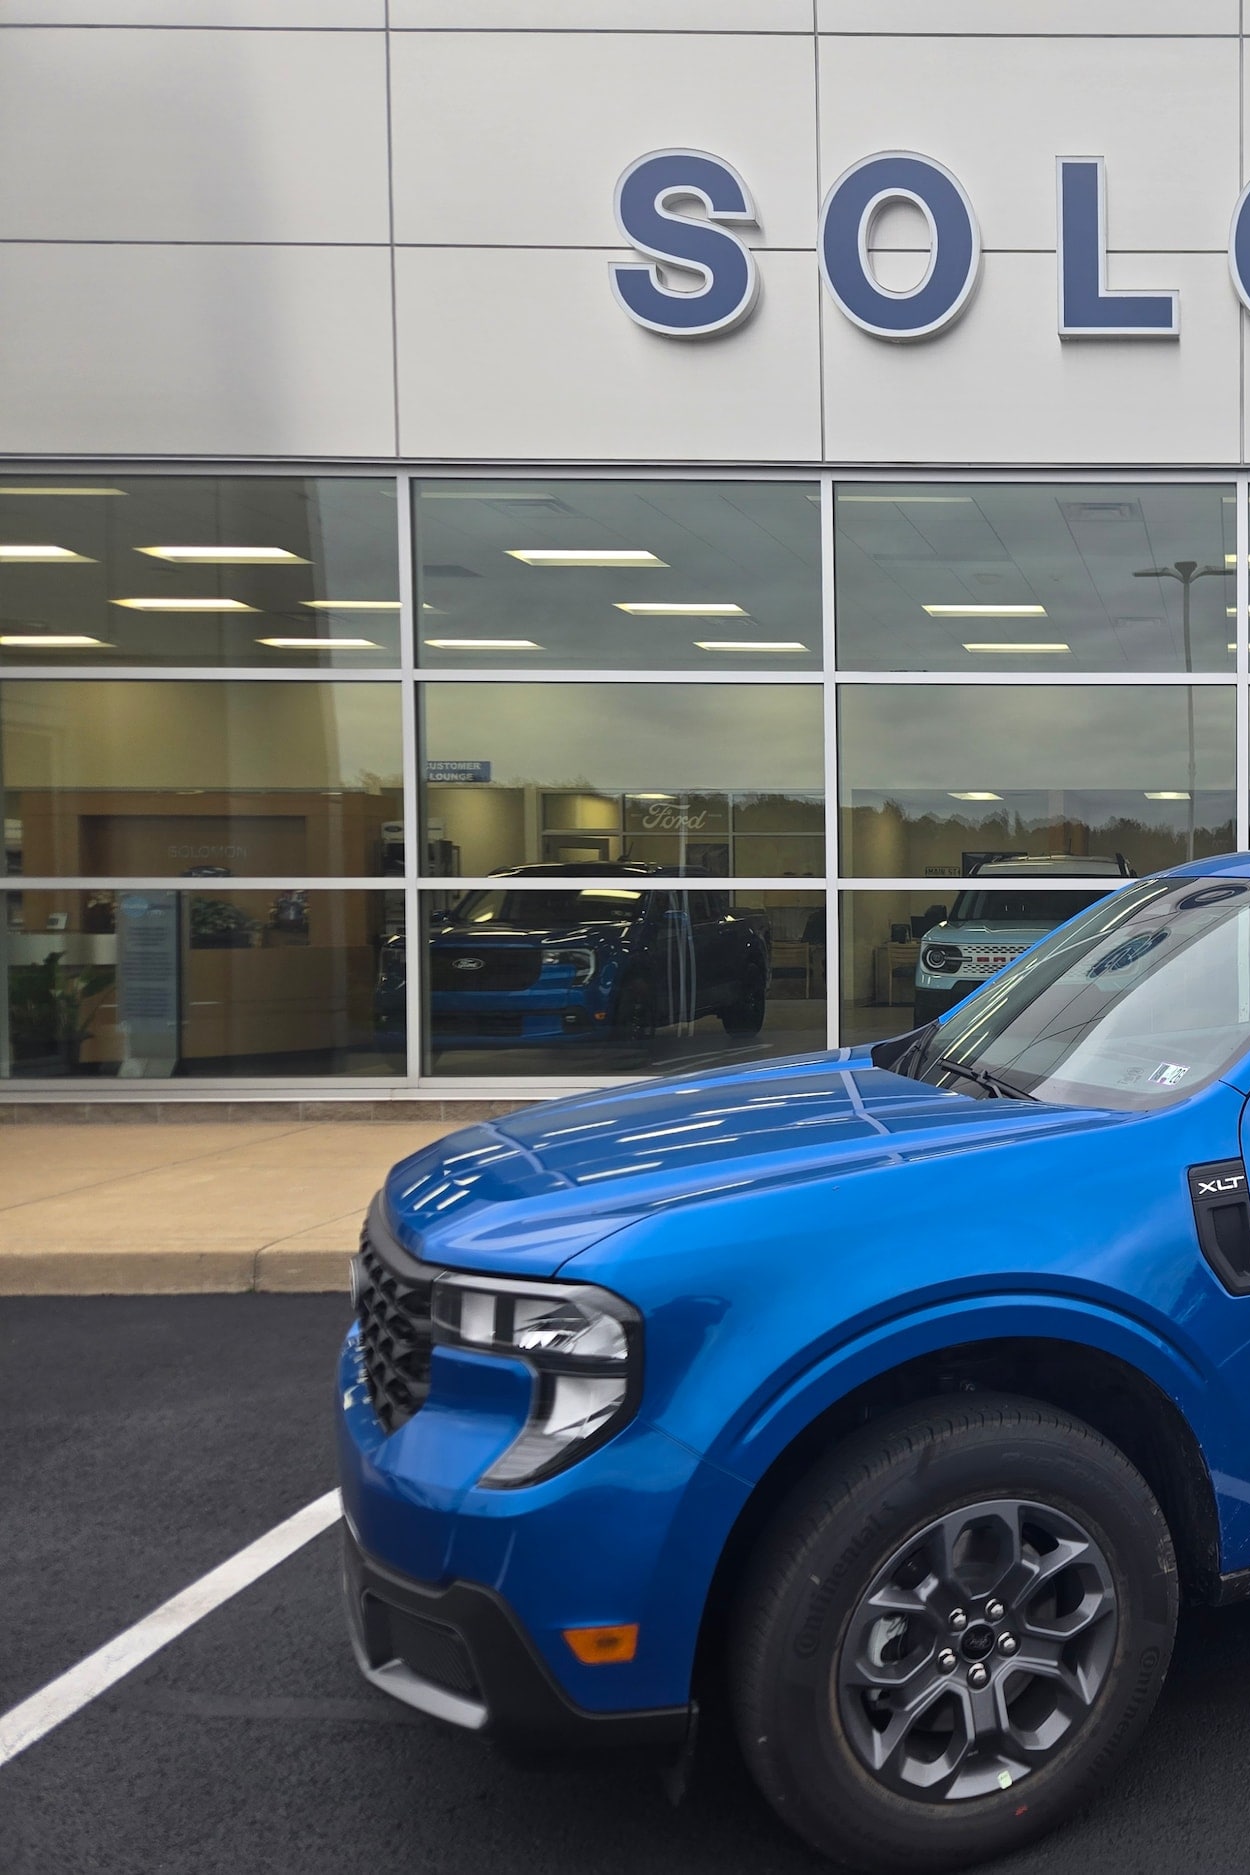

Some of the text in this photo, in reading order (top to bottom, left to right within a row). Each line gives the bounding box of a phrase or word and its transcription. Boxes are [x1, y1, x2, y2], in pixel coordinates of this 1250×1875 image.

[429, 772, 474, 781] LOUNGE
[642, 802, 707, 829] Ford
[168, 846, 248, 858] SOLOMON
[1198, 1175, 1245, 1195] XLT
[793, 1513, 884, 1660] Continental
[1086, 1645, 1160, 1778] Continental
